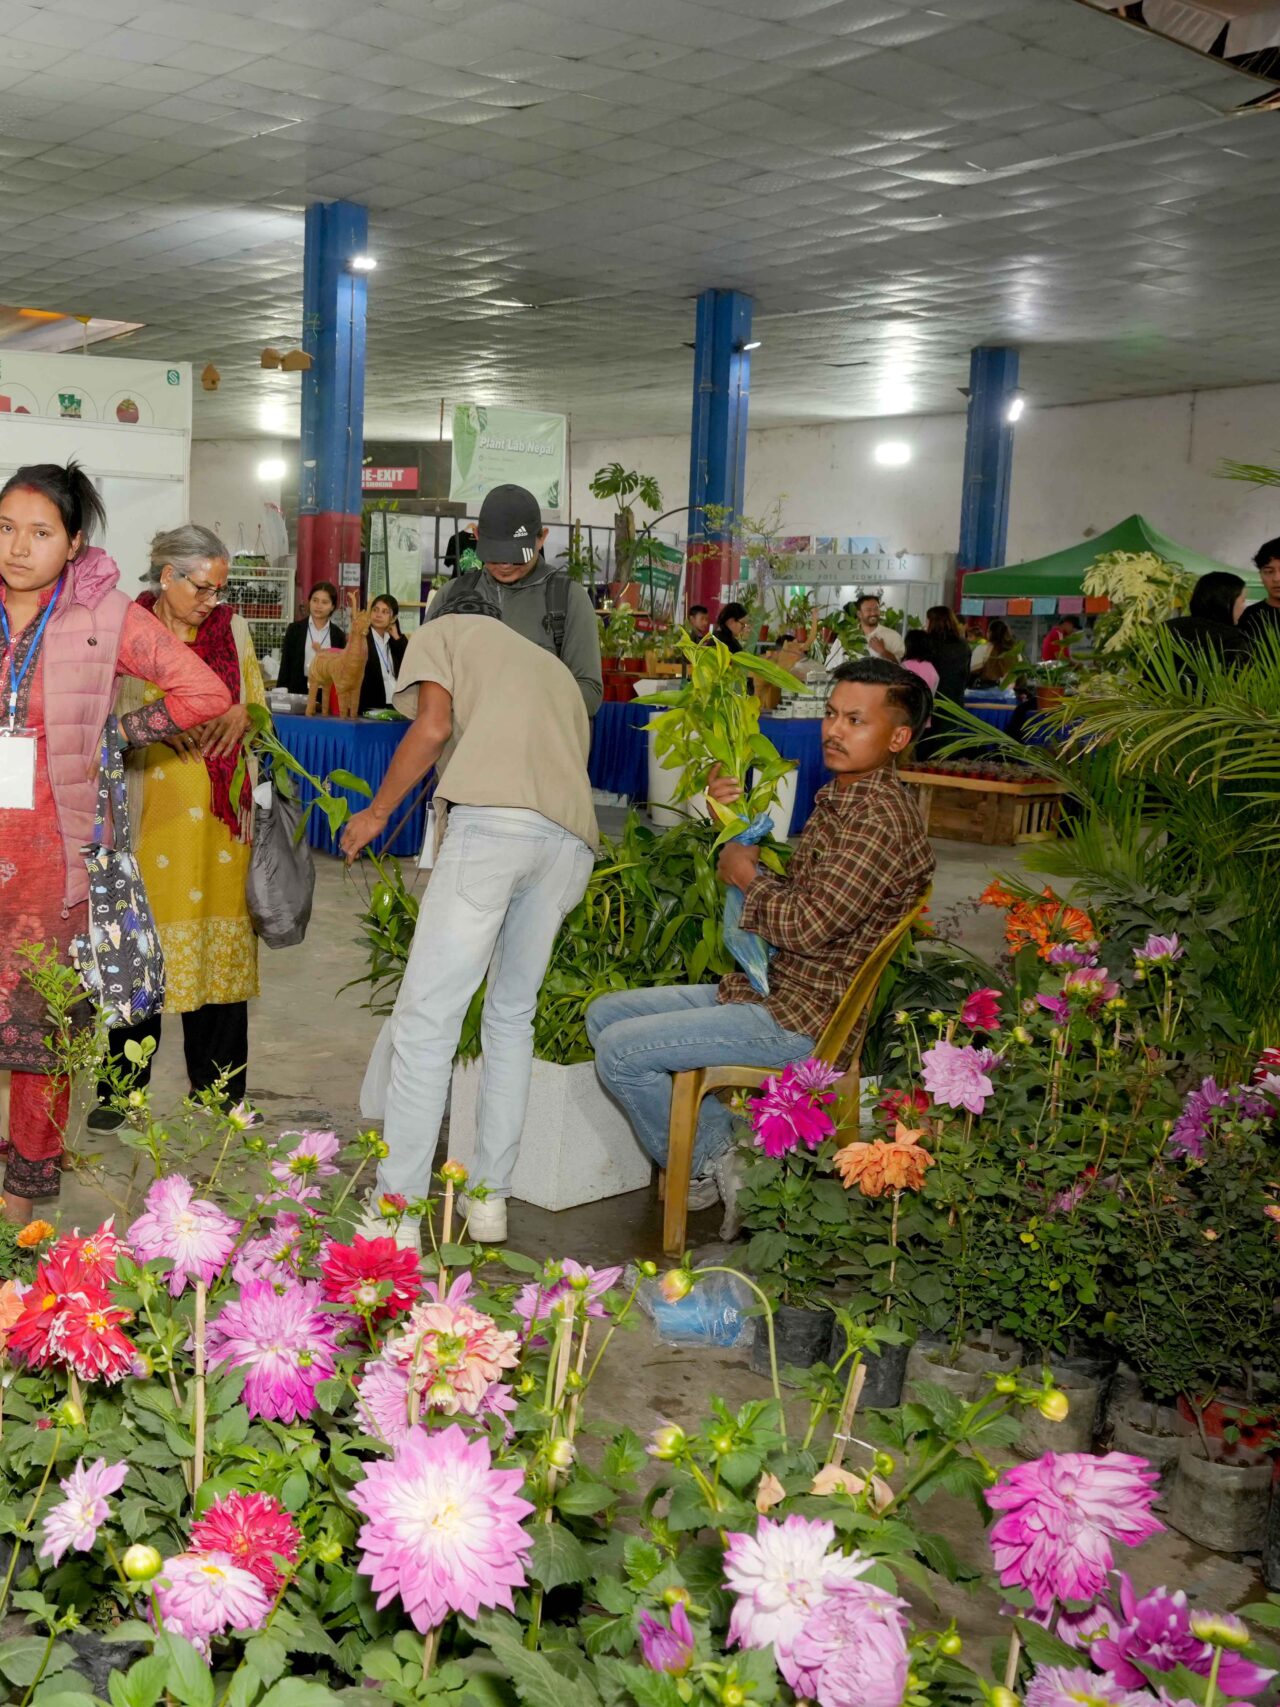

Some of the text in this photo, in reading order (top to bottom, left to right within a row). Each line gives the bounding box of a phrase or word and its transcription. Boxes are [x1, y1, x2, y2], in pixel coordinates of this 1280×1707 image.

[479, 436, 555, 457] Plant Lab Nepal
[512, 530, 528, 538] adidas
[836, 558, 909, 571] CENTER
